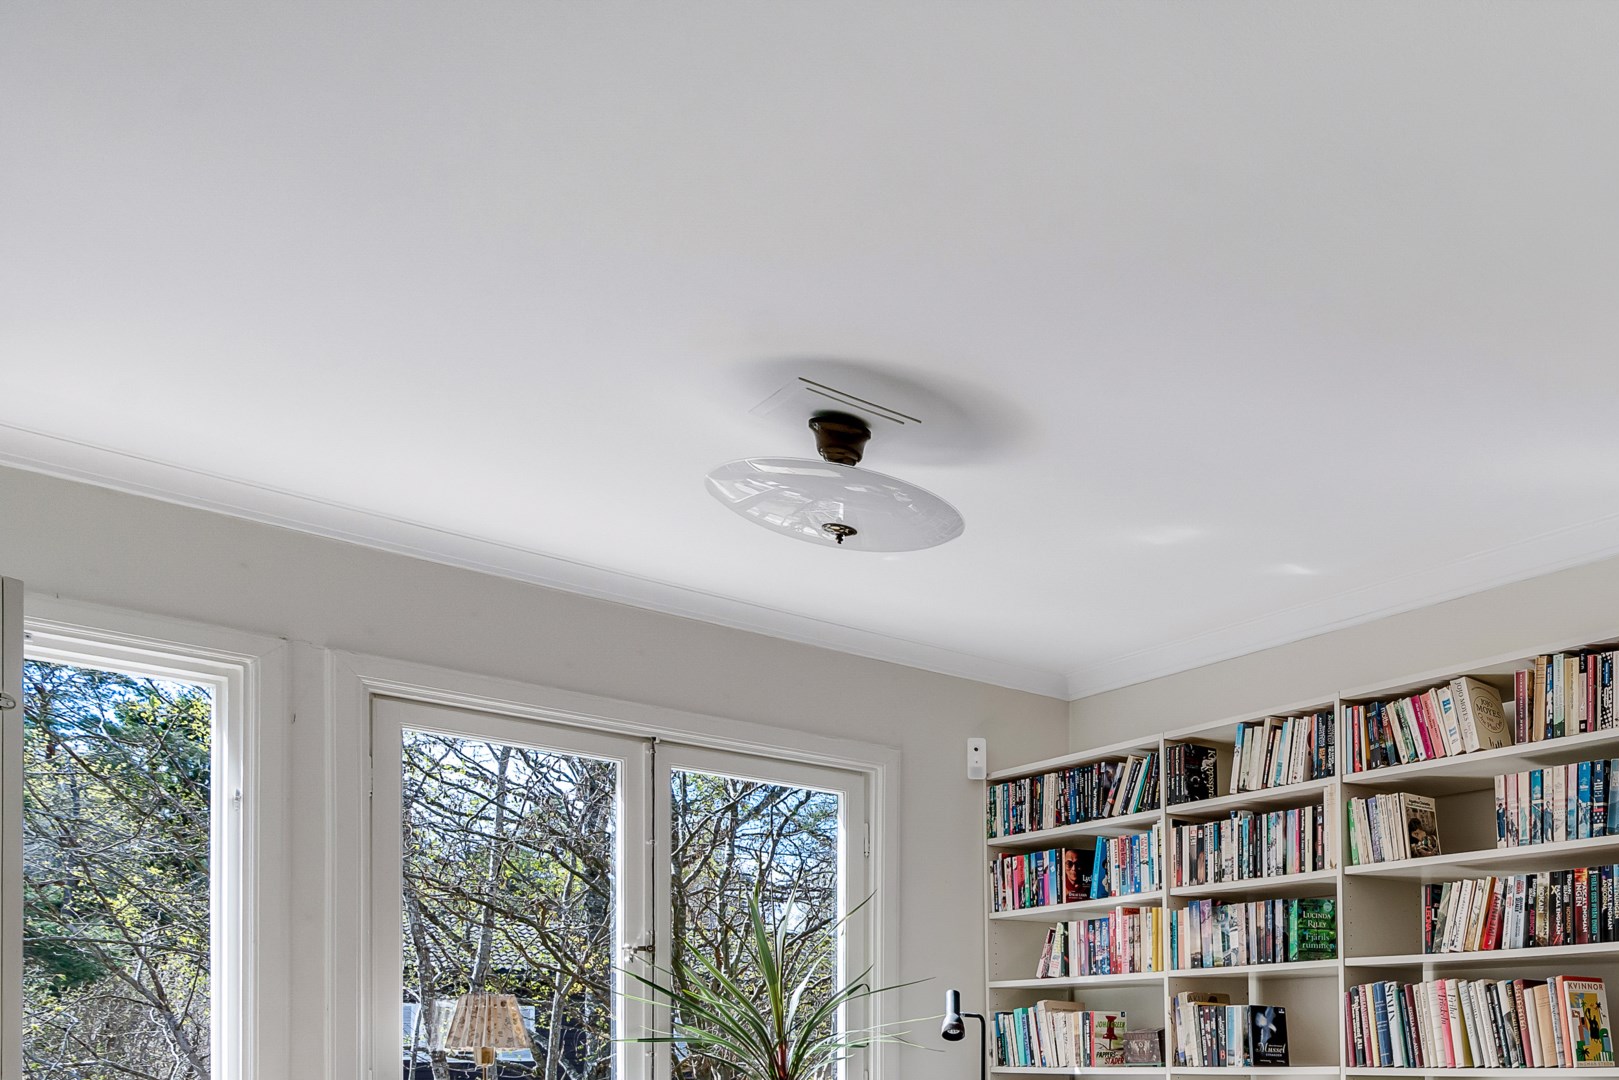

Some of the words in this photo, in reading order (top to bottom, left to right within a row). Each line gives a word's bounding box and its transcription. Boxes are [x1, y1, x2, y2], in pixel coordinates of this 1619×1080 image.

[1454, 682, 1465, 698] JOJO
[1459, 698, 1470, 721] MOYES
[1480, 698, 1493, 708] JOJO
[1475, 703, 1502, 719] MOYES
[1082, 874, 1093, 884] Lyc
[1575, 882, 1583, 907] INGEN
[1302, 910, 1331, 919] LUCINDA
[1307, 919, 1327, 929] RILEY
[1568, 982, 1603, 990] KVINNOR
[1386, 984, 1395, 1022] STALIN
